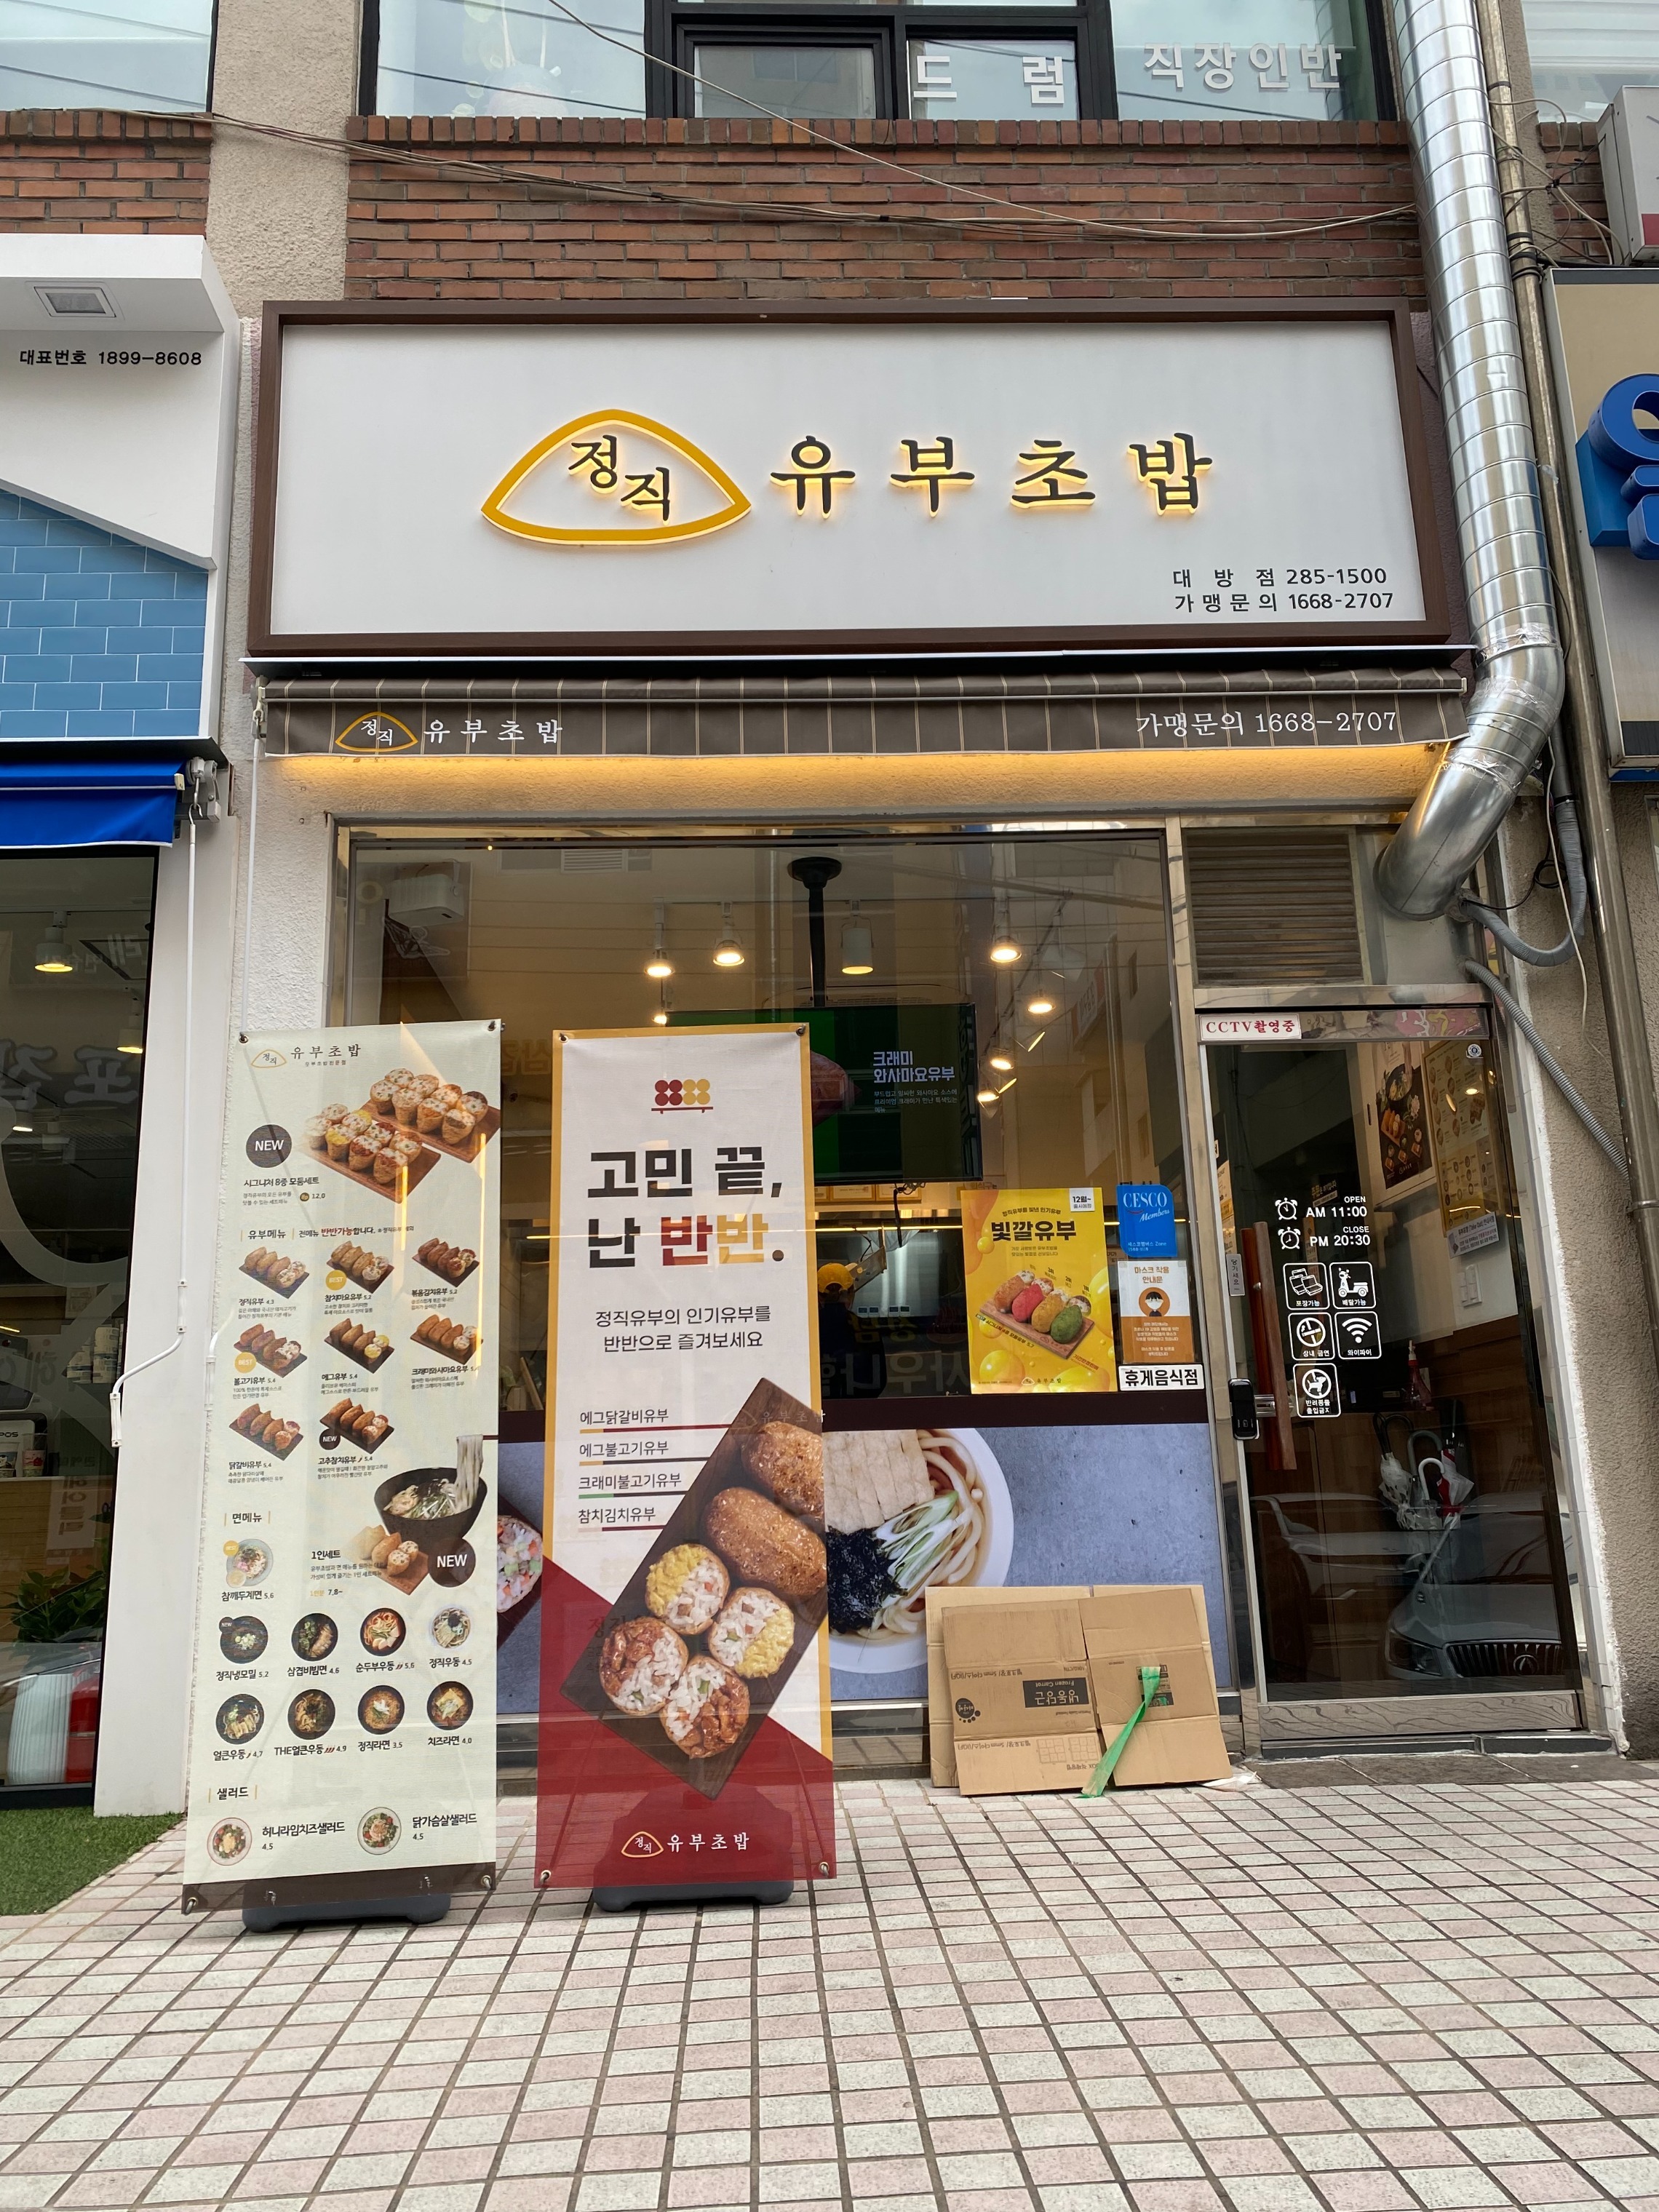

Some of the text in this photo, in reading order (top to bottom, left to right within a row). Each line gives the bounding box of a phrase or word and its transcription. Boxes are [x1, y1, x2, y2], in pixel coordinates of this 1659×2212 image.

[1144, 41, 1342, 89] 직장인반
[20, 349, 202, 365] 대표번호 1899-8608
[568, 434, 672, 522] 정직
[1286, 568, 1387, 585] 285-1500
[1174, 592, 1393, 613] 가맹문의 1668-2707
[1136, 712, 1397, 738] 가맹문의 1668-2707
[361, 719, 393, 746] 정직
[873, 1051, 912, 1066] 크래미
[874, 1066, 955, 1083] 와사마요유부
[255, 1139, 284, 1151] NEW
[588, 1146, 782, 1198] 고민 끝,
[244, 1178, 274, 1187] 시그니처
[1123, 1192, 1167, 1208] CESCO
[1344, 1195, 1366, 1204] OPEN
[1139, 1208, 1170, 1222] Members
[1305, 1206, 1367, 1218] AM 11:00
[248, 1229, 286, 1239] 유부메뉴
[299, 1230, 319, 1238] 전메뉴
[321, 1227, 375, 1237] 반반가능합니다.
[991, 1220, 1077, 1242] 빛깔유부
[1342, 1225, 1369, 1233] CLOSE
[589, 1213, 784, 1268] 난 반반.
[1310, 1235, 1370, 1246] PM 20:30
[1155, 1266, 1169, 1274] 착용
[239, 1298, 264, 1306] 정직유부
[325, 1293, 362, 1302] 참치마요유부
[1342, 1298, 1366, 1306] 배달가능
[595, 1305, 771, 1327] 정직유부의 인기유부를
[604, 1332, 763, 1353] 반반으로 즐겨보세요
[234, 1377, 265, 1386] 불고기유부
[322, 1373, 347, 1381] 에그유부
[1125, 1369, 1198, 1388] 휴게음식점
[580, 1409, 669, 1425] 에그닭갈비유부
[579, 1441, 669, 1457] 에그불고기유부
[229, 1460, 262, 1470] 닭갈비유부
[318, 1456, 357, 1465] 고추참치유부
[578, 1473, 682, 1490] 크래미불고기유부
[232, 1513, 262, 1524] 면메뉴
[578, 1506, 656, 1524] 참치김치유부
[311, 1550, 341, 1559] 1인세트
[437, 1554, 467, 1568] NEW
[356, 1661, 394, 1672] 순두부우동
[429, 1658, 461, 1668] 정직우동
[216, 1669, 256, 1681] 정직냉모밀
[287, 1666, 327, 1676] 삼겹비빔면
[1034, 1690, 1080, 1706] 냉동당근
[358, 1740, 390, 1751] 정직라면
[428, 1736, 460, 1746] 치즈라면
[213, 1749, 246, 1761] 얼큰우동
[274, 1744, 324, 1756] THE얼큰우동
[217, 1786, 249, 1800] 샐러드
[413, 1813, 477, 1828] 닭가슴살샐러드
[262, 1821, 346, 1837] 허니라임치즈샐러드
[634, 1836, 652, 1853] 정직
